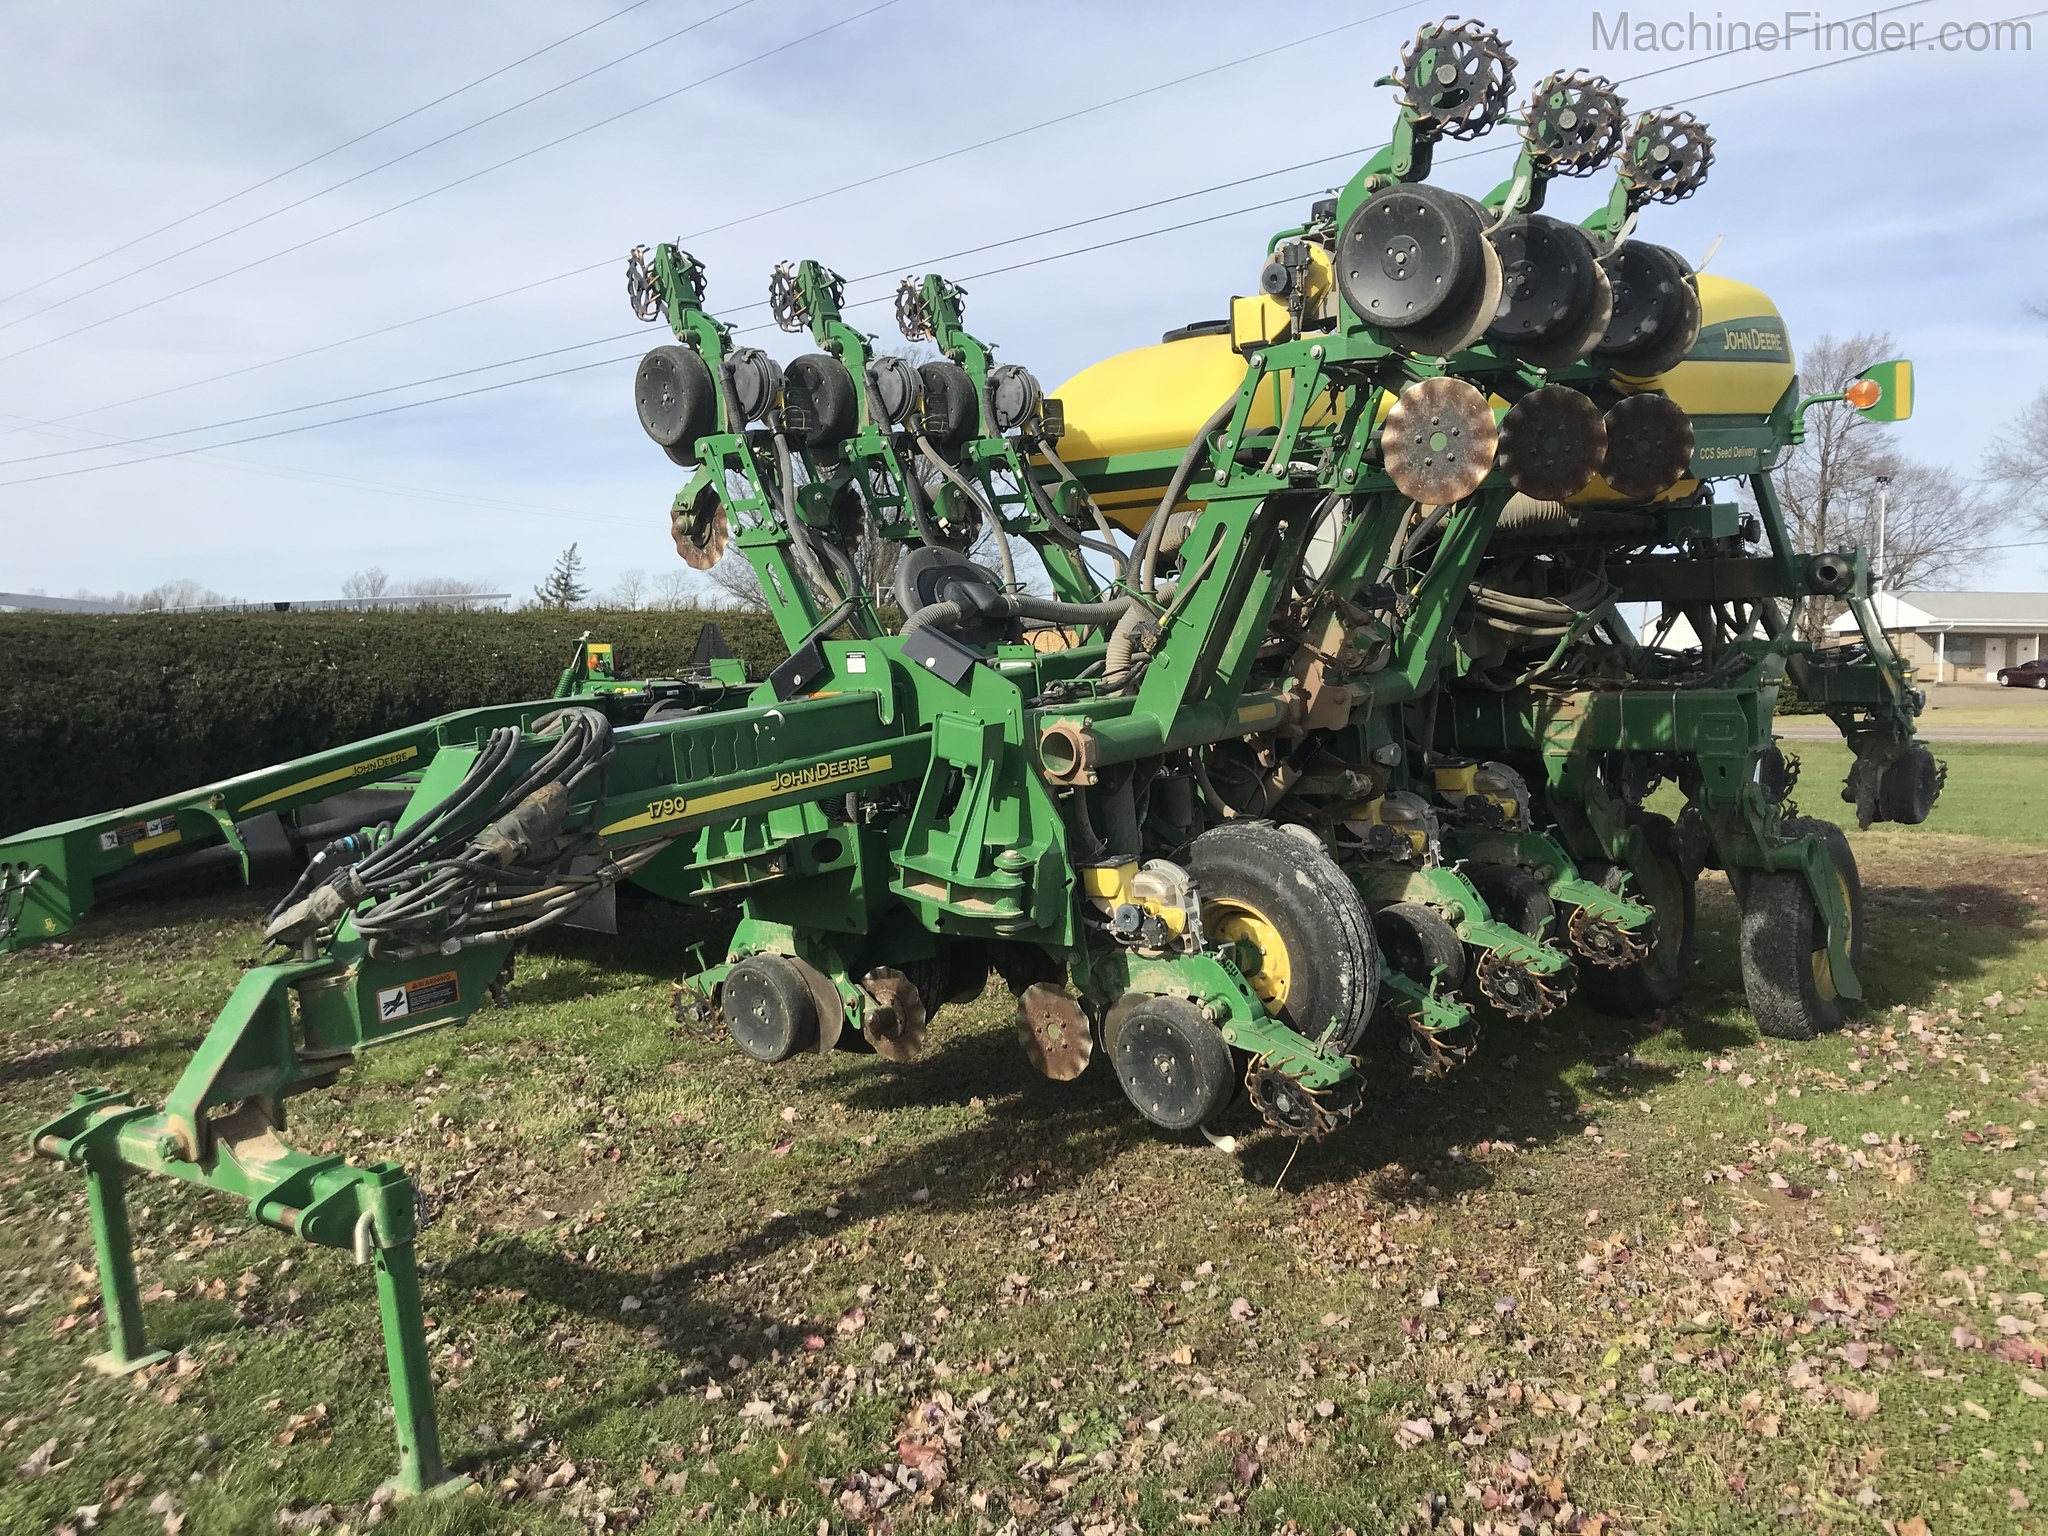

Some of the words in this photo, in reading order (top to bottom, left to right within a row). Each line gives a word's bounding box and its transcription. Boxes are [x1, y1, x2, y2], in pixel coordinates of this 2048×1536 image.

[1724, 327, 1752, 350] JOHN
[1750, 328, 1782, 351] DEERE
[1700, 447, 1715, 459] CCS
[1716, 446, 1732, 459] Seed
[1733, 445, 1757, 458] Delivery
[351, 762, 377, 776] JOHN
[377, 752, 408, 768] DEERE
[771, 766, 815, 791] JOHN
[815, 755, 869, 779] DEERE
[646, 796, 686, 819] 1790
[418, 973, 451, 987] WARNING
